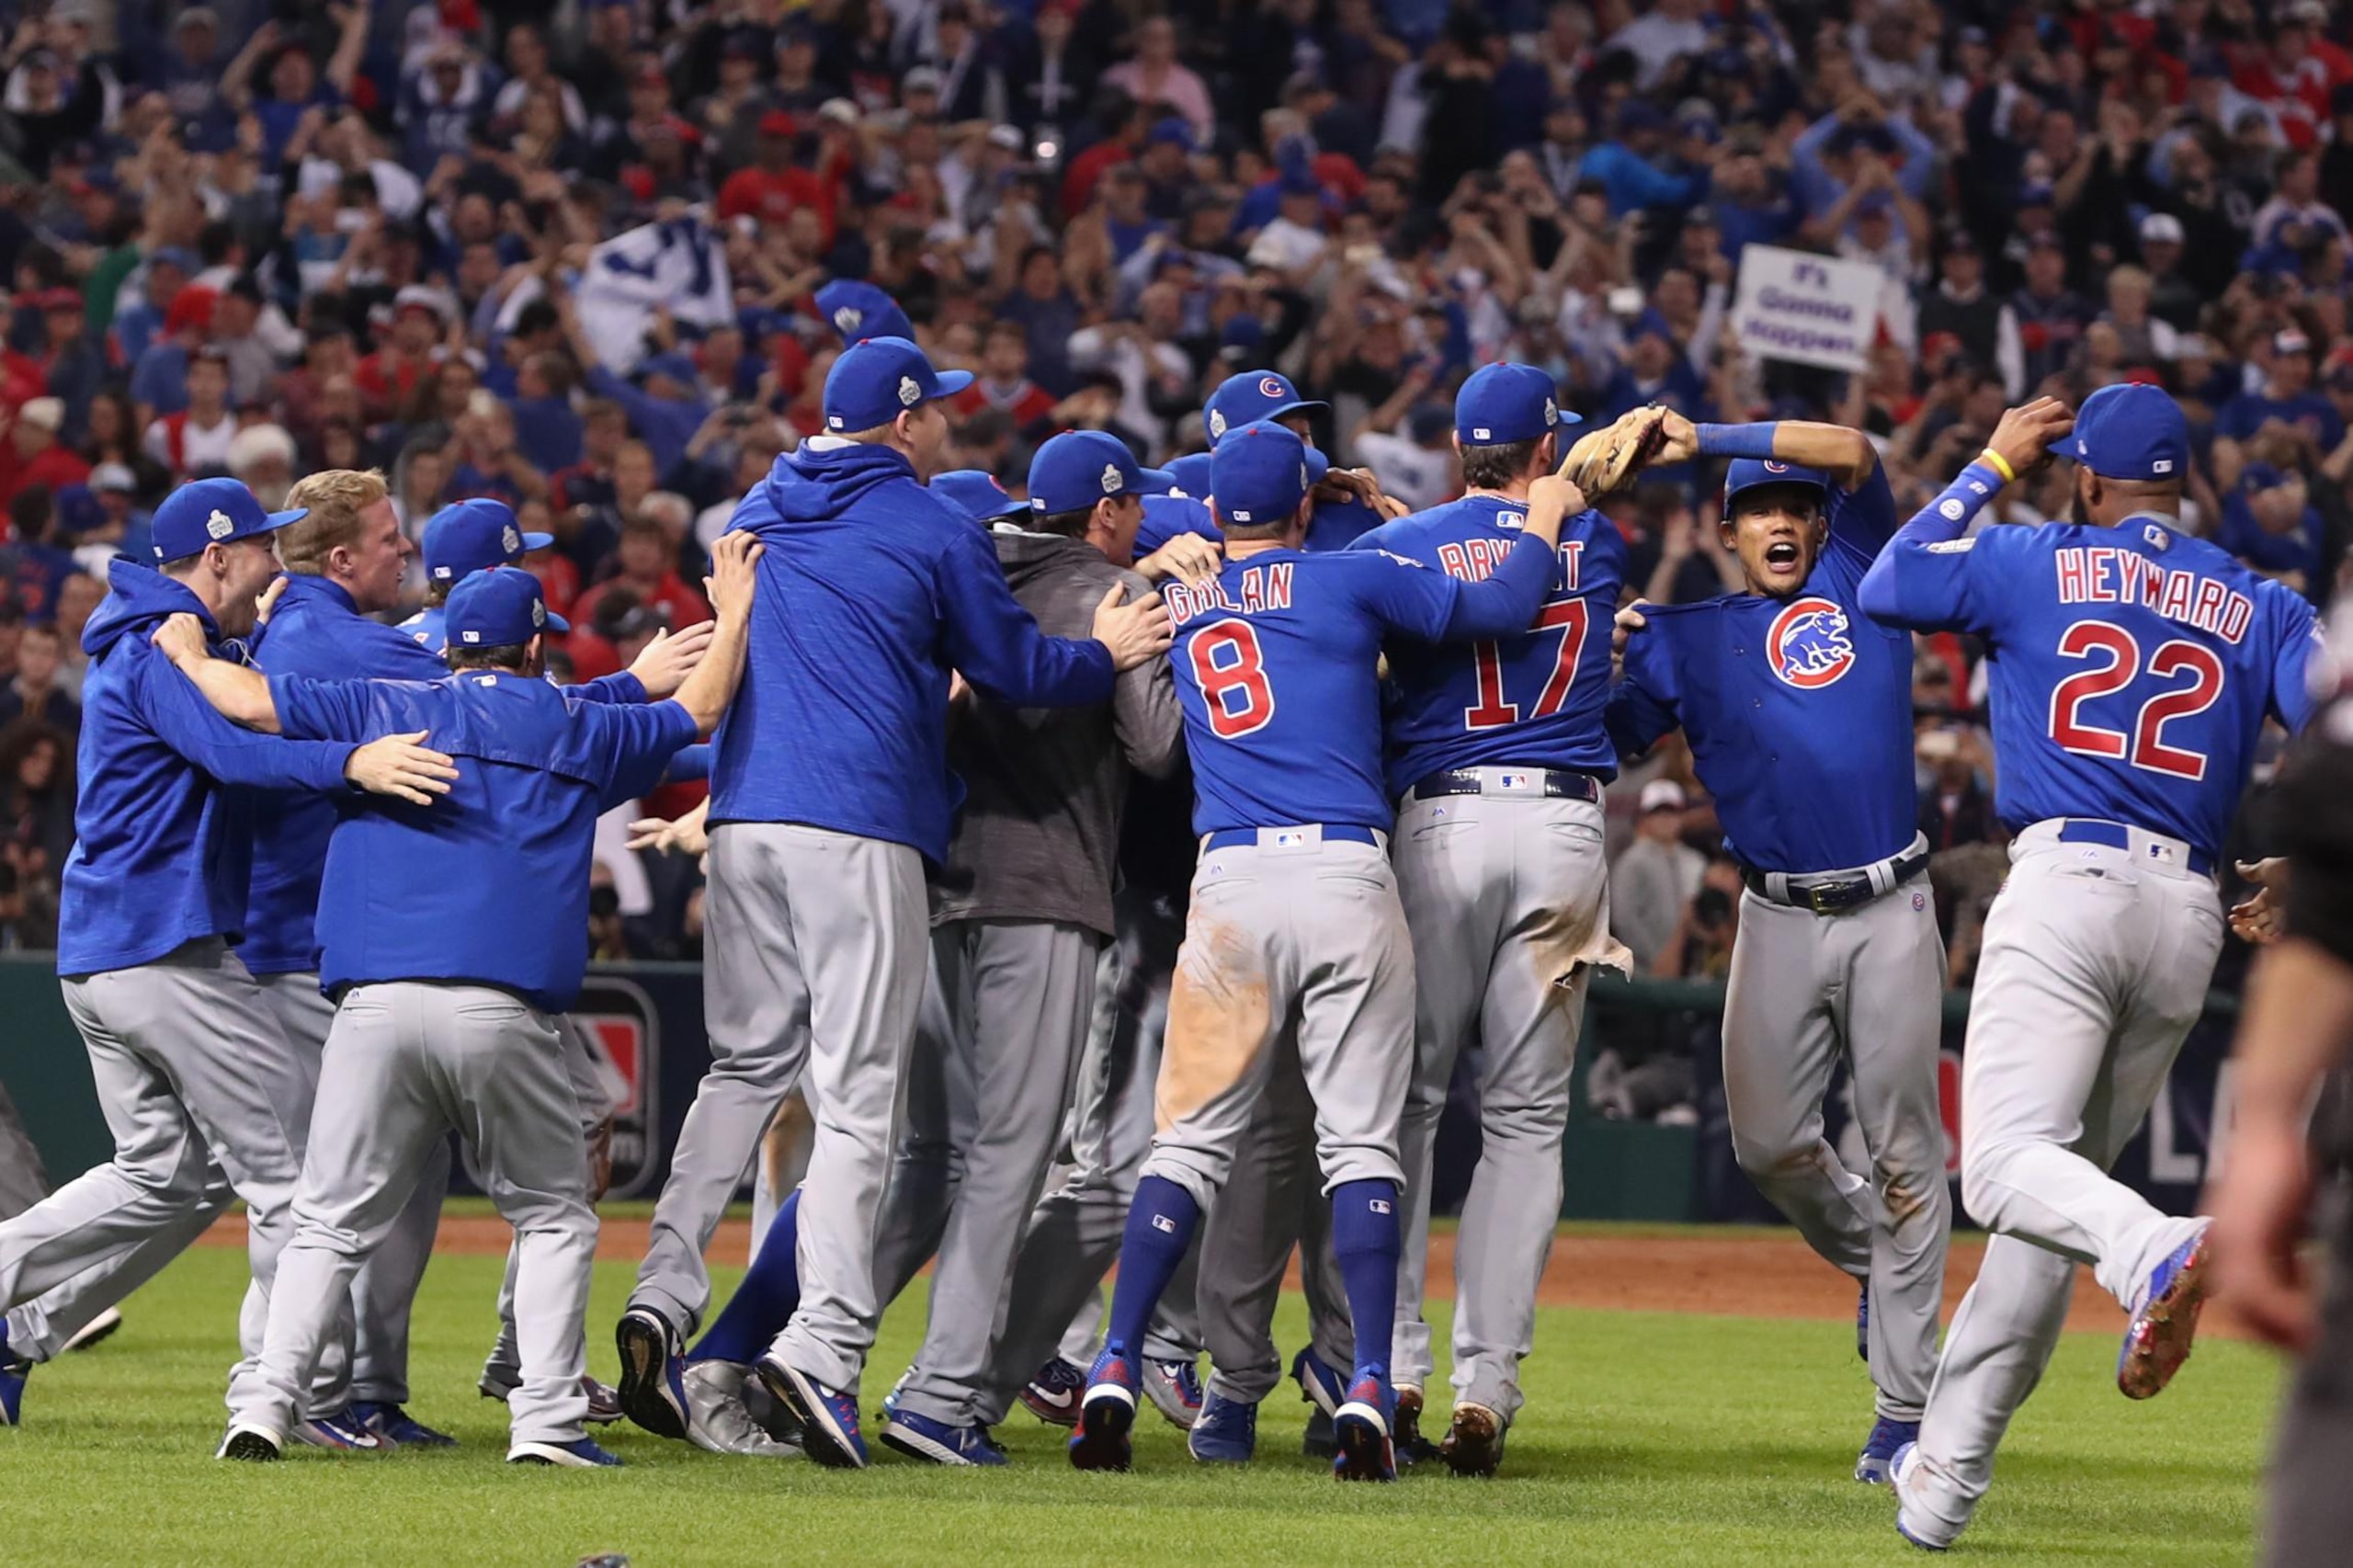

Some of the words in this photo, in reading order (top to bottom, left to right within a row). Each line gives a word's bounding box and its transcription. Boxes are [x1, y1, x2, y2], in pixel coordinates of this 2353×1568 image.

[2055, 547, 2254, 643] HEYWARD
[1188, 617, 1275, 740] 8
[1465, 597, 1589, 731] 17
[2048, 619, 2225, 781] 22
